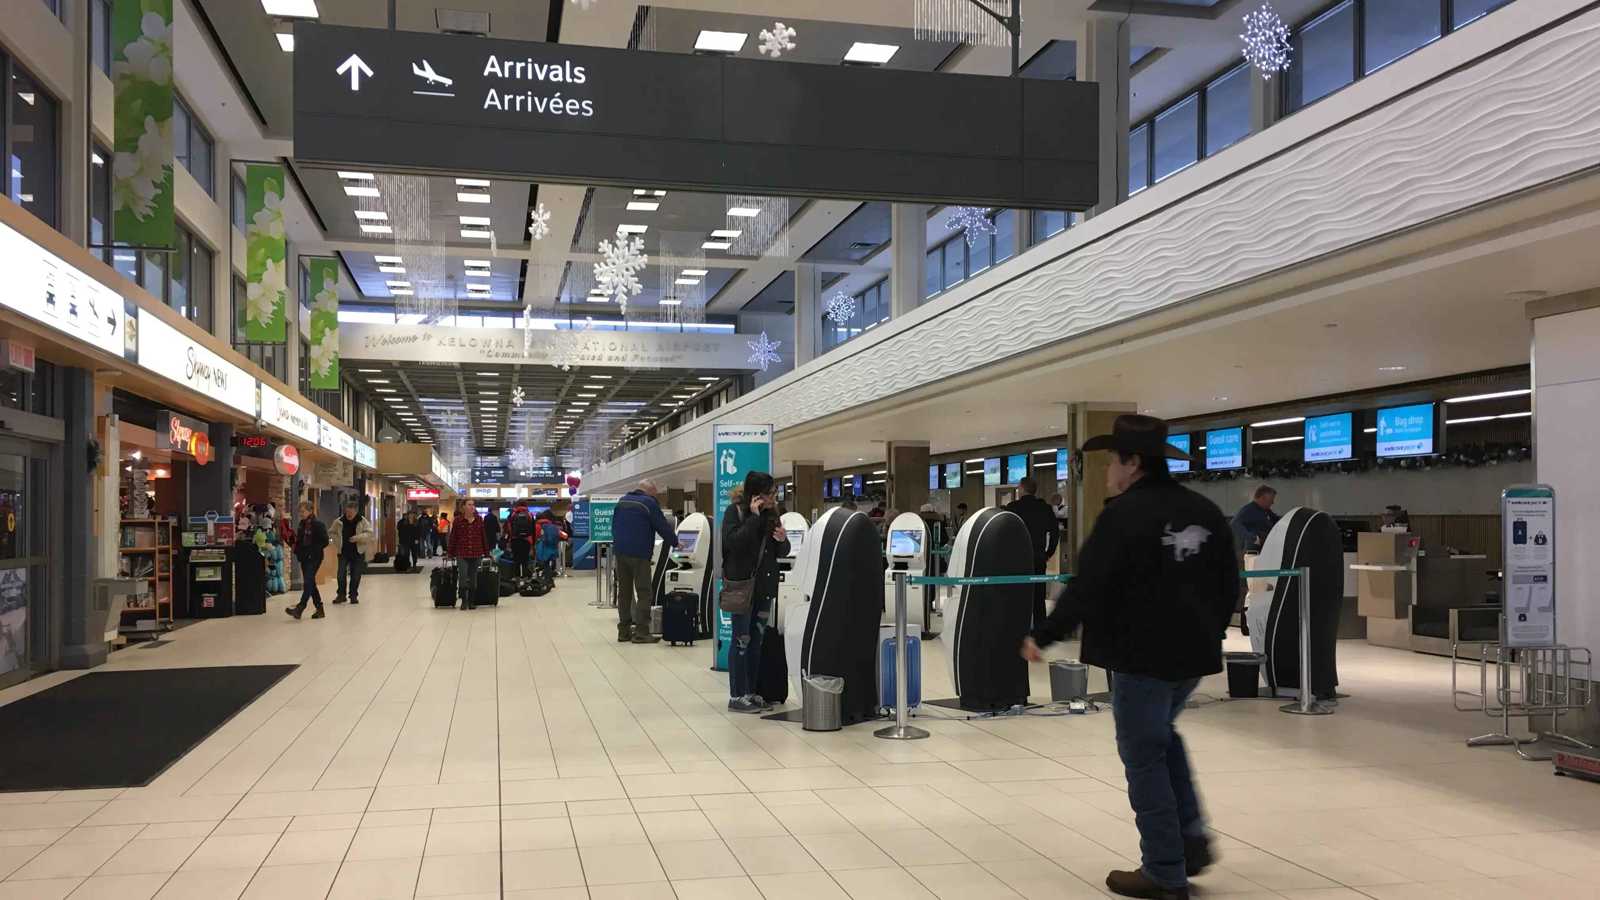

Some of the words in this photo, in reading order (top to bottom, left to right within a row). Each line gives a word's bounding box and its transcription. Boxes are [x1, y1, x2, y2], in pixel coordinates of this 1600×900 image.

[483, 55, 586, 83] Arrivals
[483, 88, 594, 117] Arrivées
[364, 334, 418, 349] Welcome
[437, 336, 516, 349] KELOWNA
